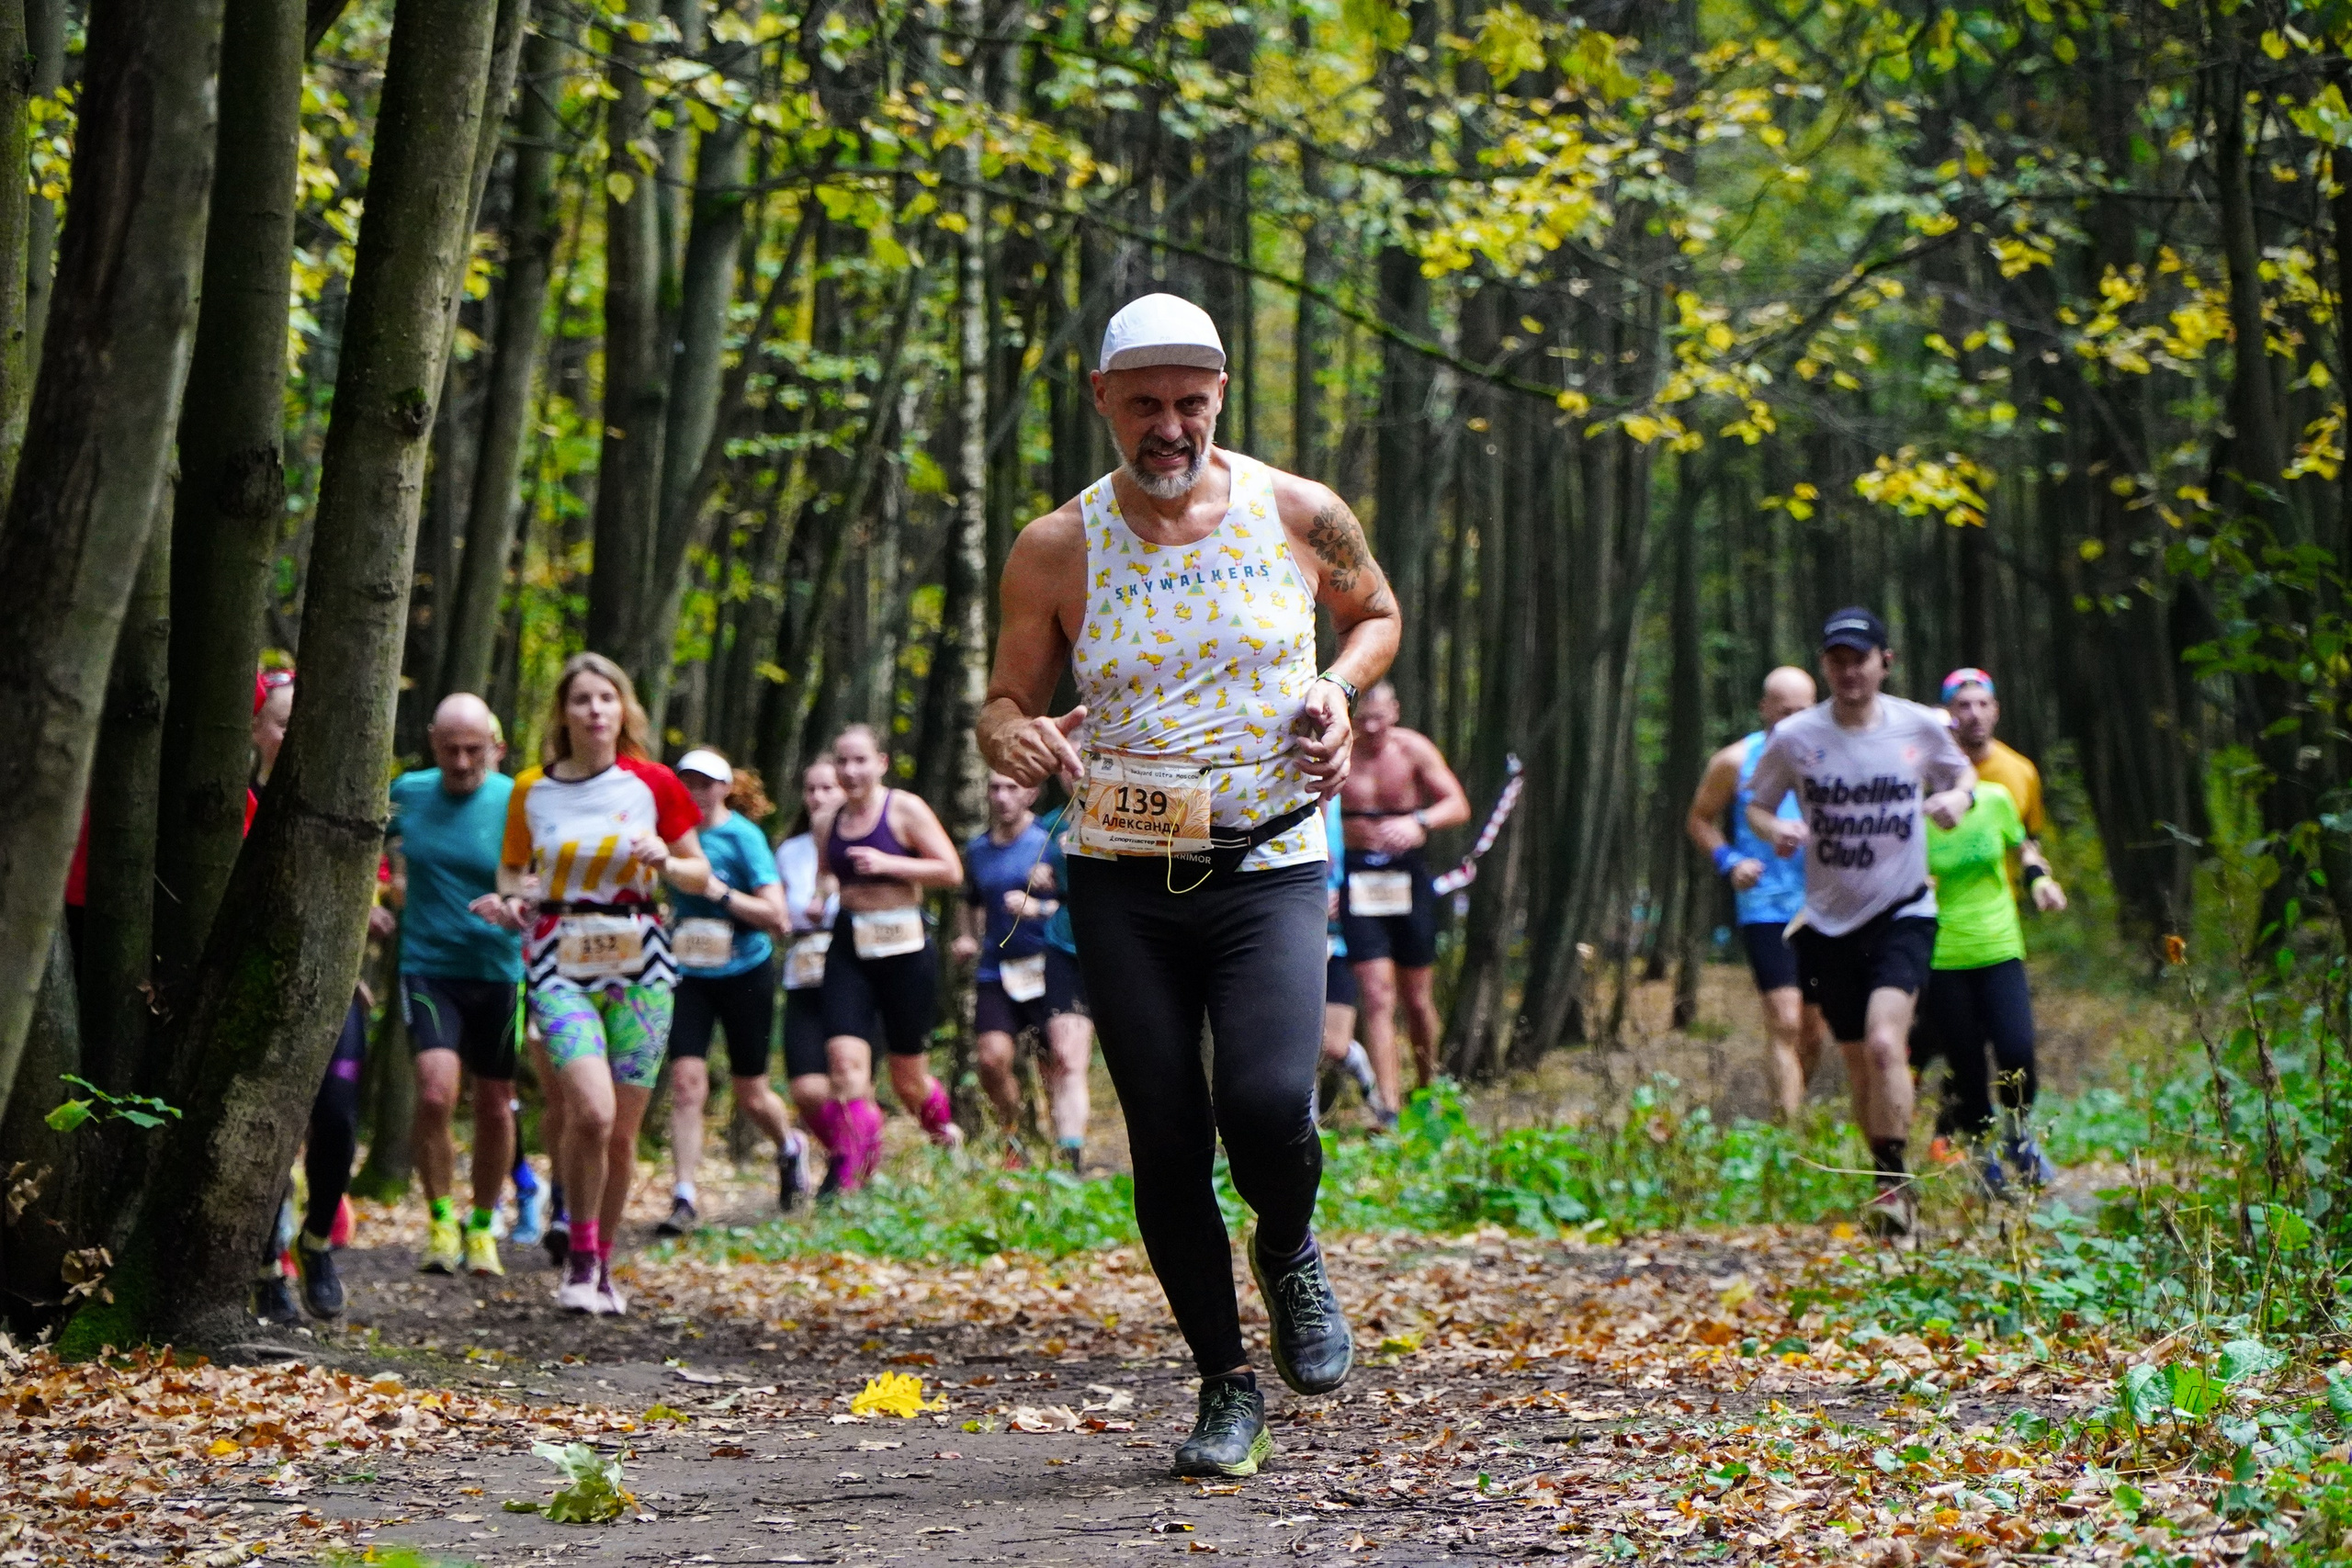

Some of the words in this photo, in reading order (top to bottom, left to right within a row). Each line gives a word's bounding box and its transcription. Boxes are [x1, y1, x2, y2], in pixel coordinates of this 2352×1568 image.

[1114, 564, 1270, 600] SKYWALKERS
[1115, 786, 1167, 816] 139
[1102, 814, 1181, 837] Александр
[1817, 839, 1875, 868] Club
[582, 935, 617, 954] 152
